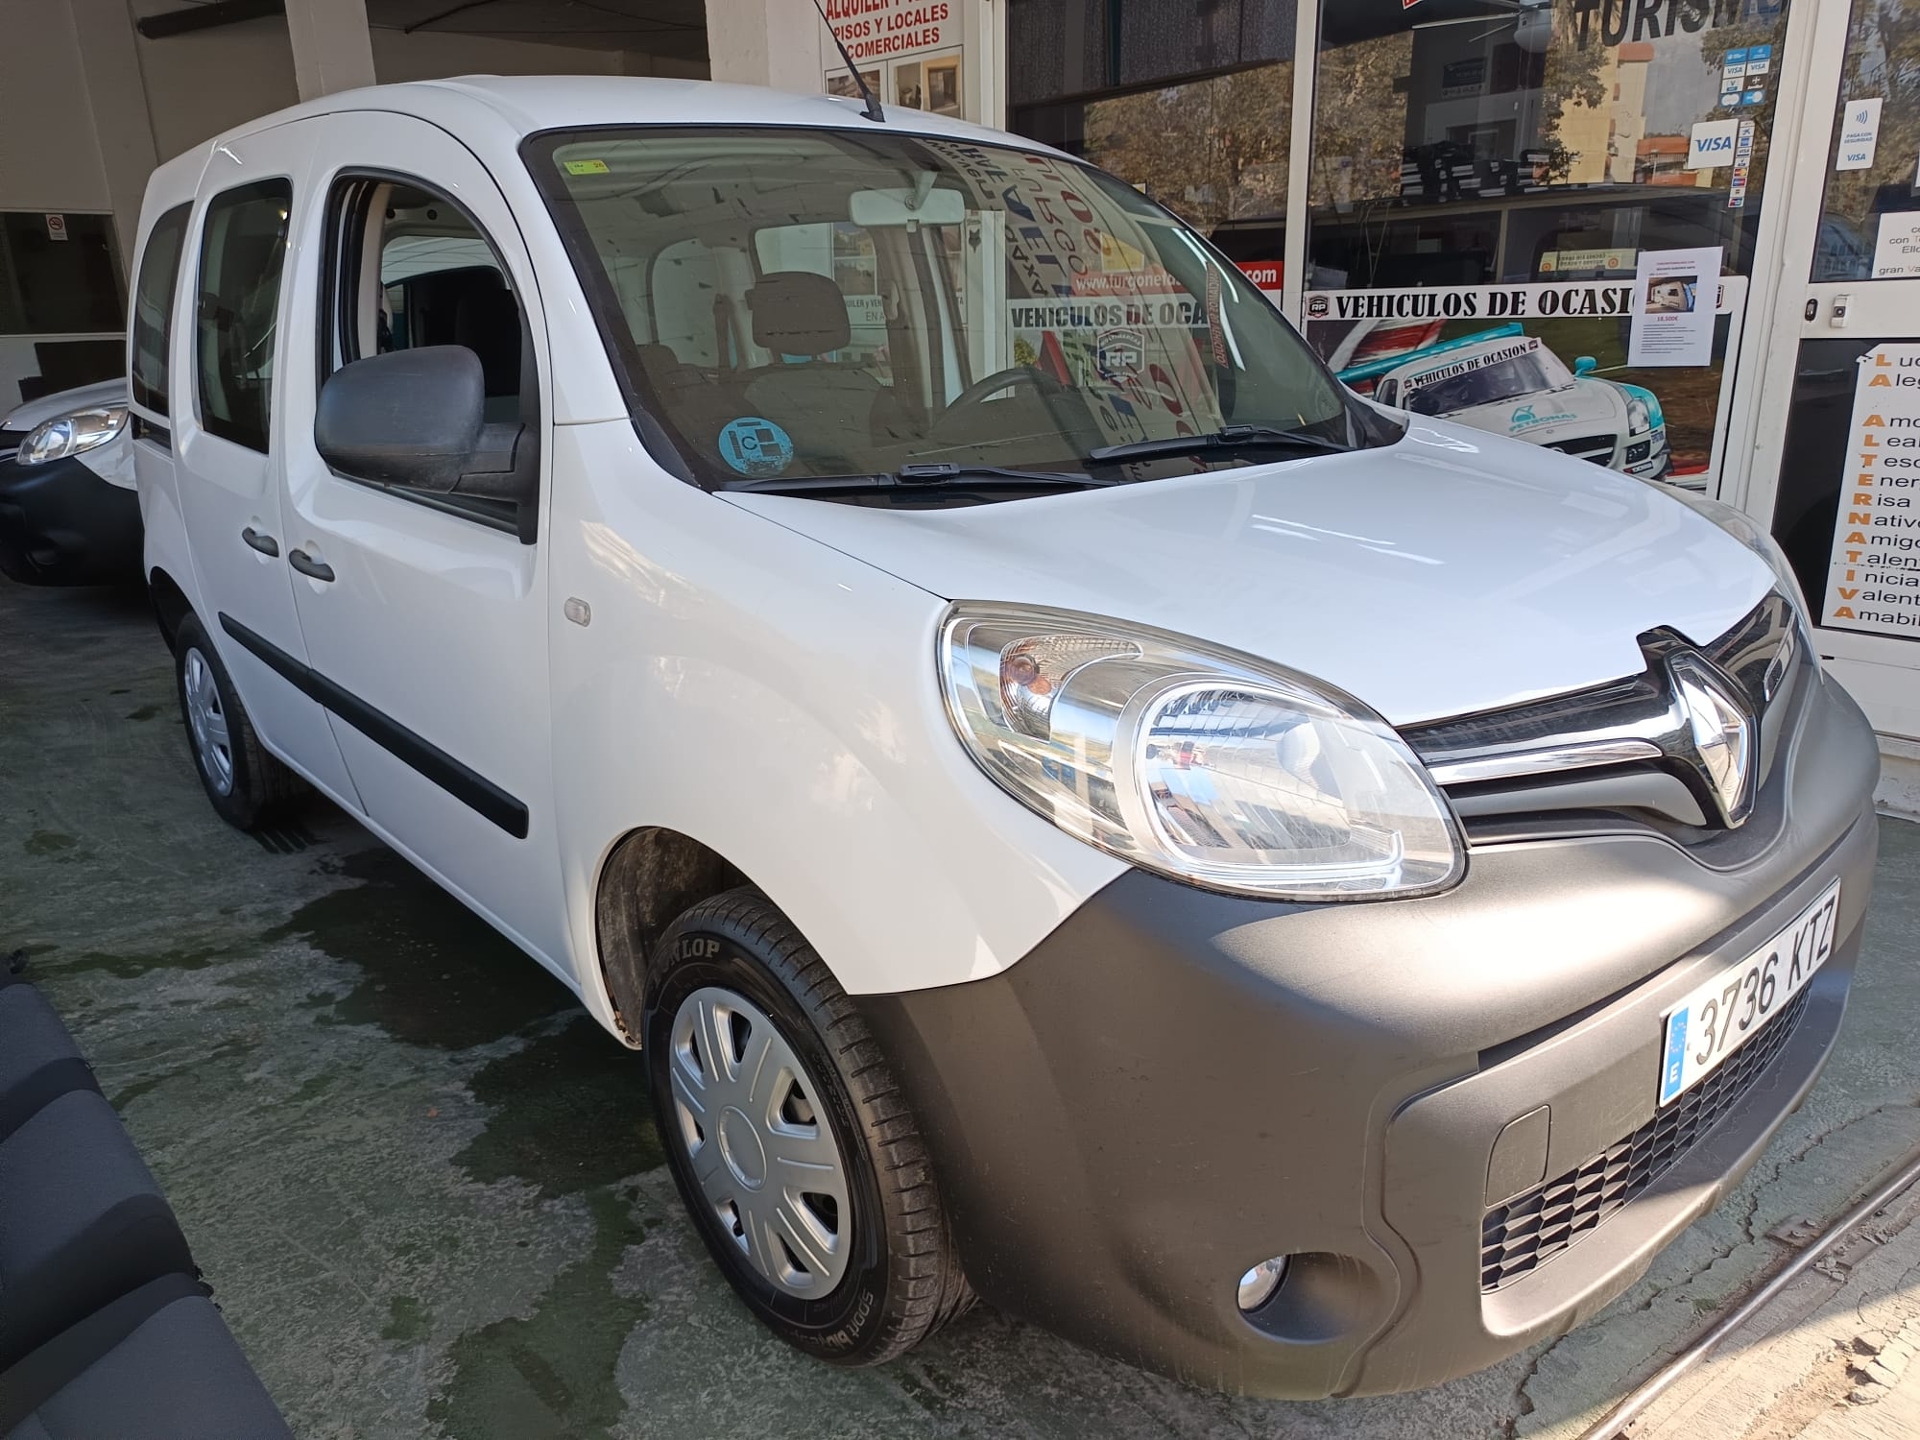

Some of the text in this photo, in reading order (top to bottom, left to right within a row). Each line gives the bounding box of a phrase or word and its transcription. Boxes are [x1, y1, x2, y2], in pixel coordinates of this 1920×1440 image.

[834, 3, 948, 41] PISOS Y LOCALES
[846, 27, 940, 60] COMERCIALES
[1695, 135, 1732, 153] VISA
[1847, 153, 1866, 161] VISA
[1879, 267, 1904, 276] gran
[1335, 292, 1478, 318] VEHICULOS
[1486, 291, 1528, 316] DE
[1538, 287, 1634, 316] OCASI
[1011, 303, 1124, 328] VEHICULOS
[1126, 302, 1153, 327] DE
[1105, 351, 1138, 367] RP
[1413, 363, 1466, 387] VEHICULOS
[1467, 358, 1480, 370] DE
[1484, 344, 1527, 366] OCASION
[741, 435, 758, 451] C
[1696, 894, 1836, 1066] 3736 KTZ
[1669, 1061, 1680, 1084] E
